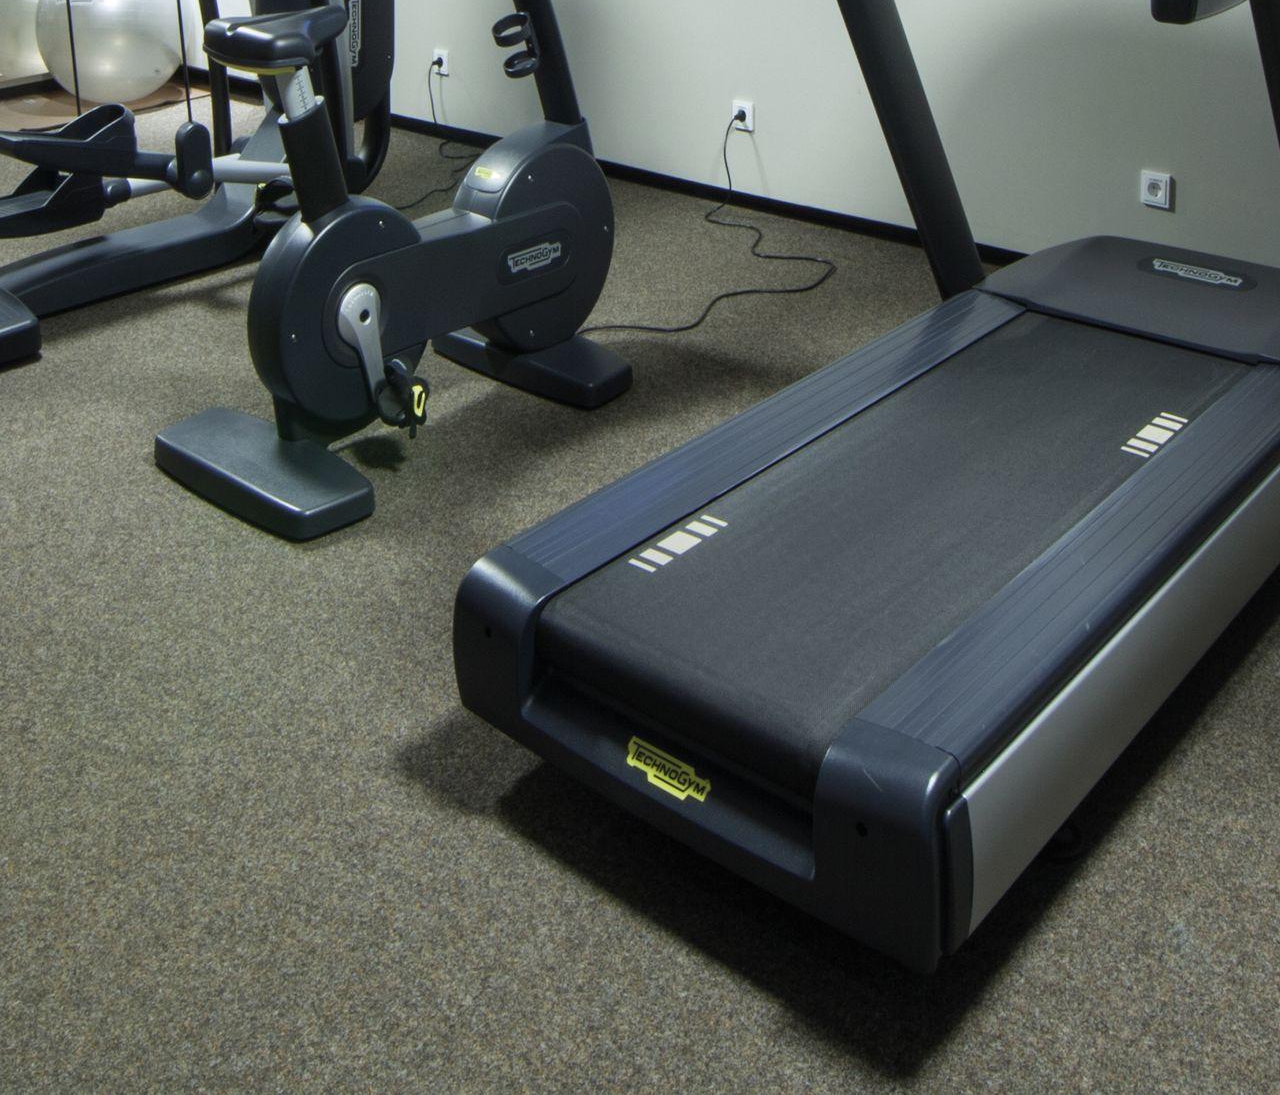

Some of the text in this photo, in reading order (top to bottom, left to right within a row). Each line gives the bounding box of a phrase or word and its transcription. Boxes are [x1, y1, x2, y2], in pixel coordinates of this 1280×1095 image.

[508, 246, 560, 269] TECHNOGYM
[1156, 260, 1239, 285] TECHNOGYM
[632, 740, 708, 797] TECHNOGYM
